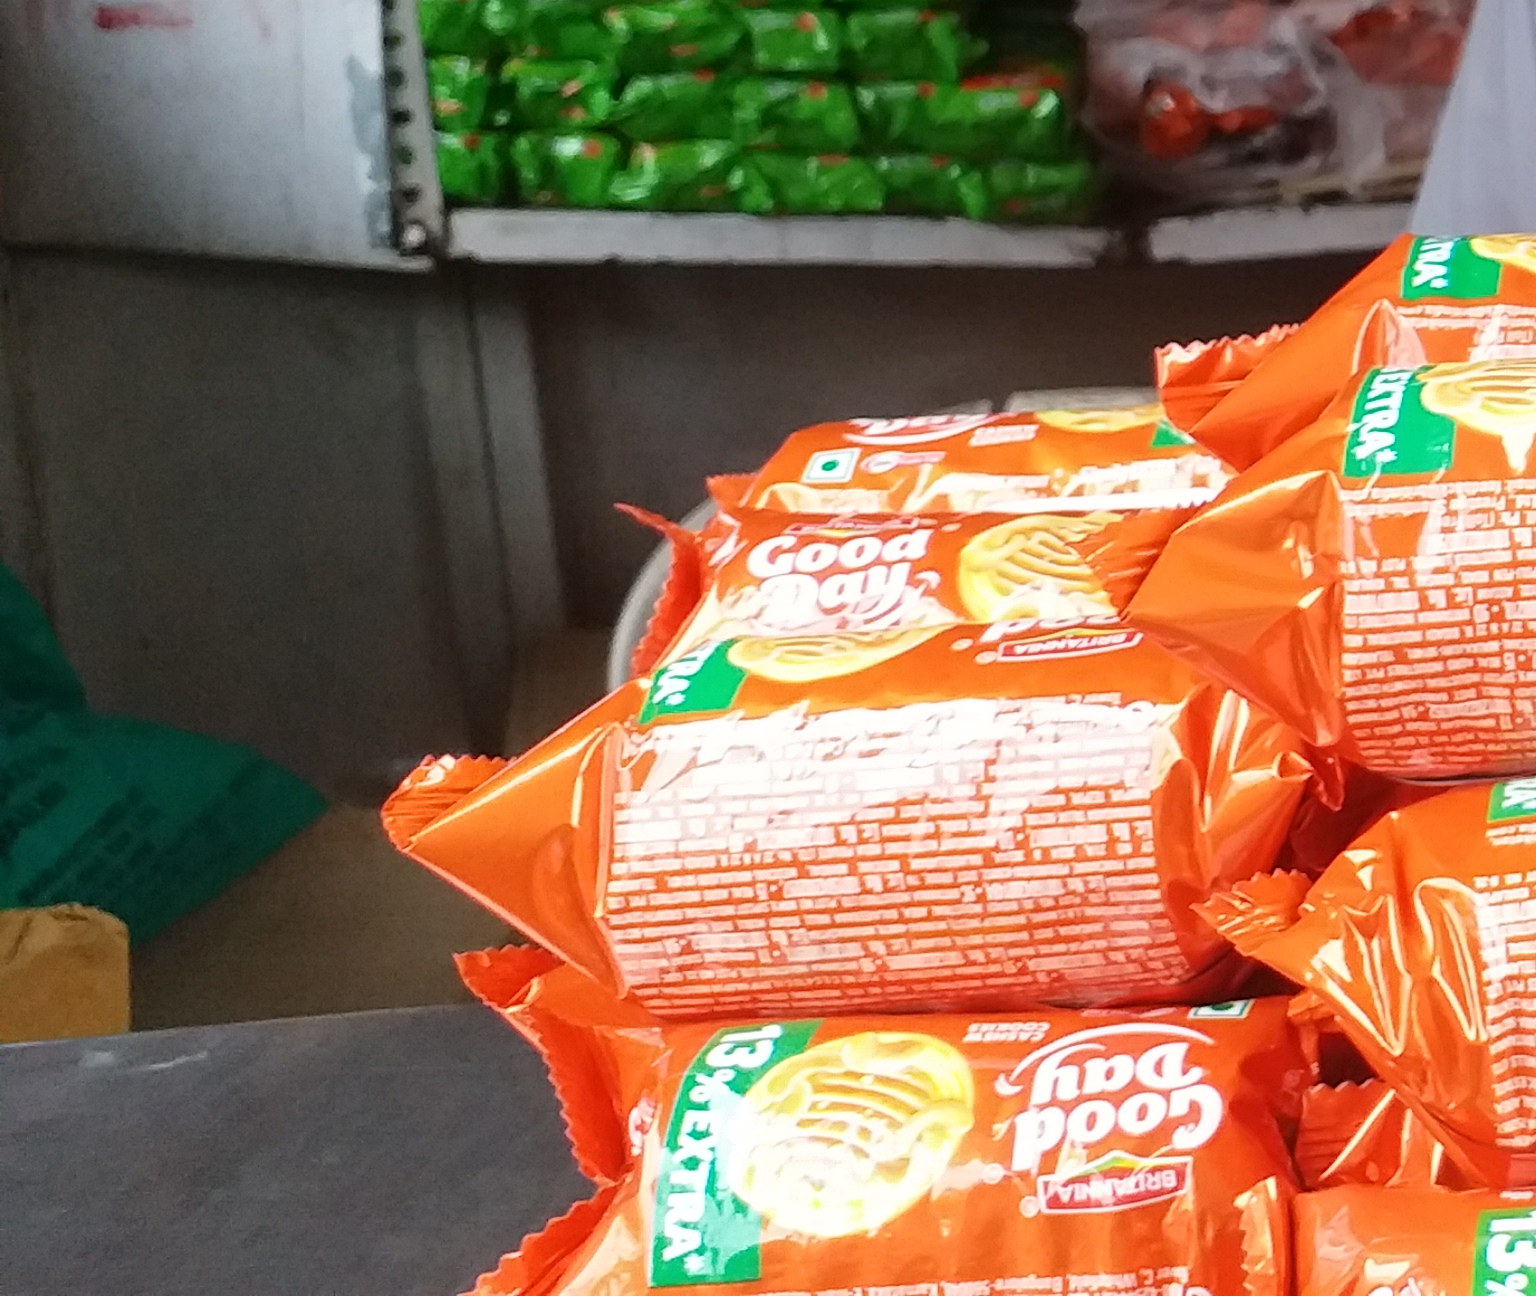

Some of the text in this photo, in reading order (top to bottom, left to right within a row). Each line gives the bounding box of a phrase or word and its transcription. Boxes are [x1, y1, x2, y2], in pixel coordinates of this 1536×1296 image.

[746, 529, 933, 579] Good
[758, 562, 912, 617] Day
[1012, 633, 1136, 654] BRITANNIA
[688, 1023, 784, 1103] 13%
[1029, 1042, 1208, 1105] Day
[1012, 1083, 1223, 1172] Good
[1058, 1169, 1177, 1202] BRITANNIA
